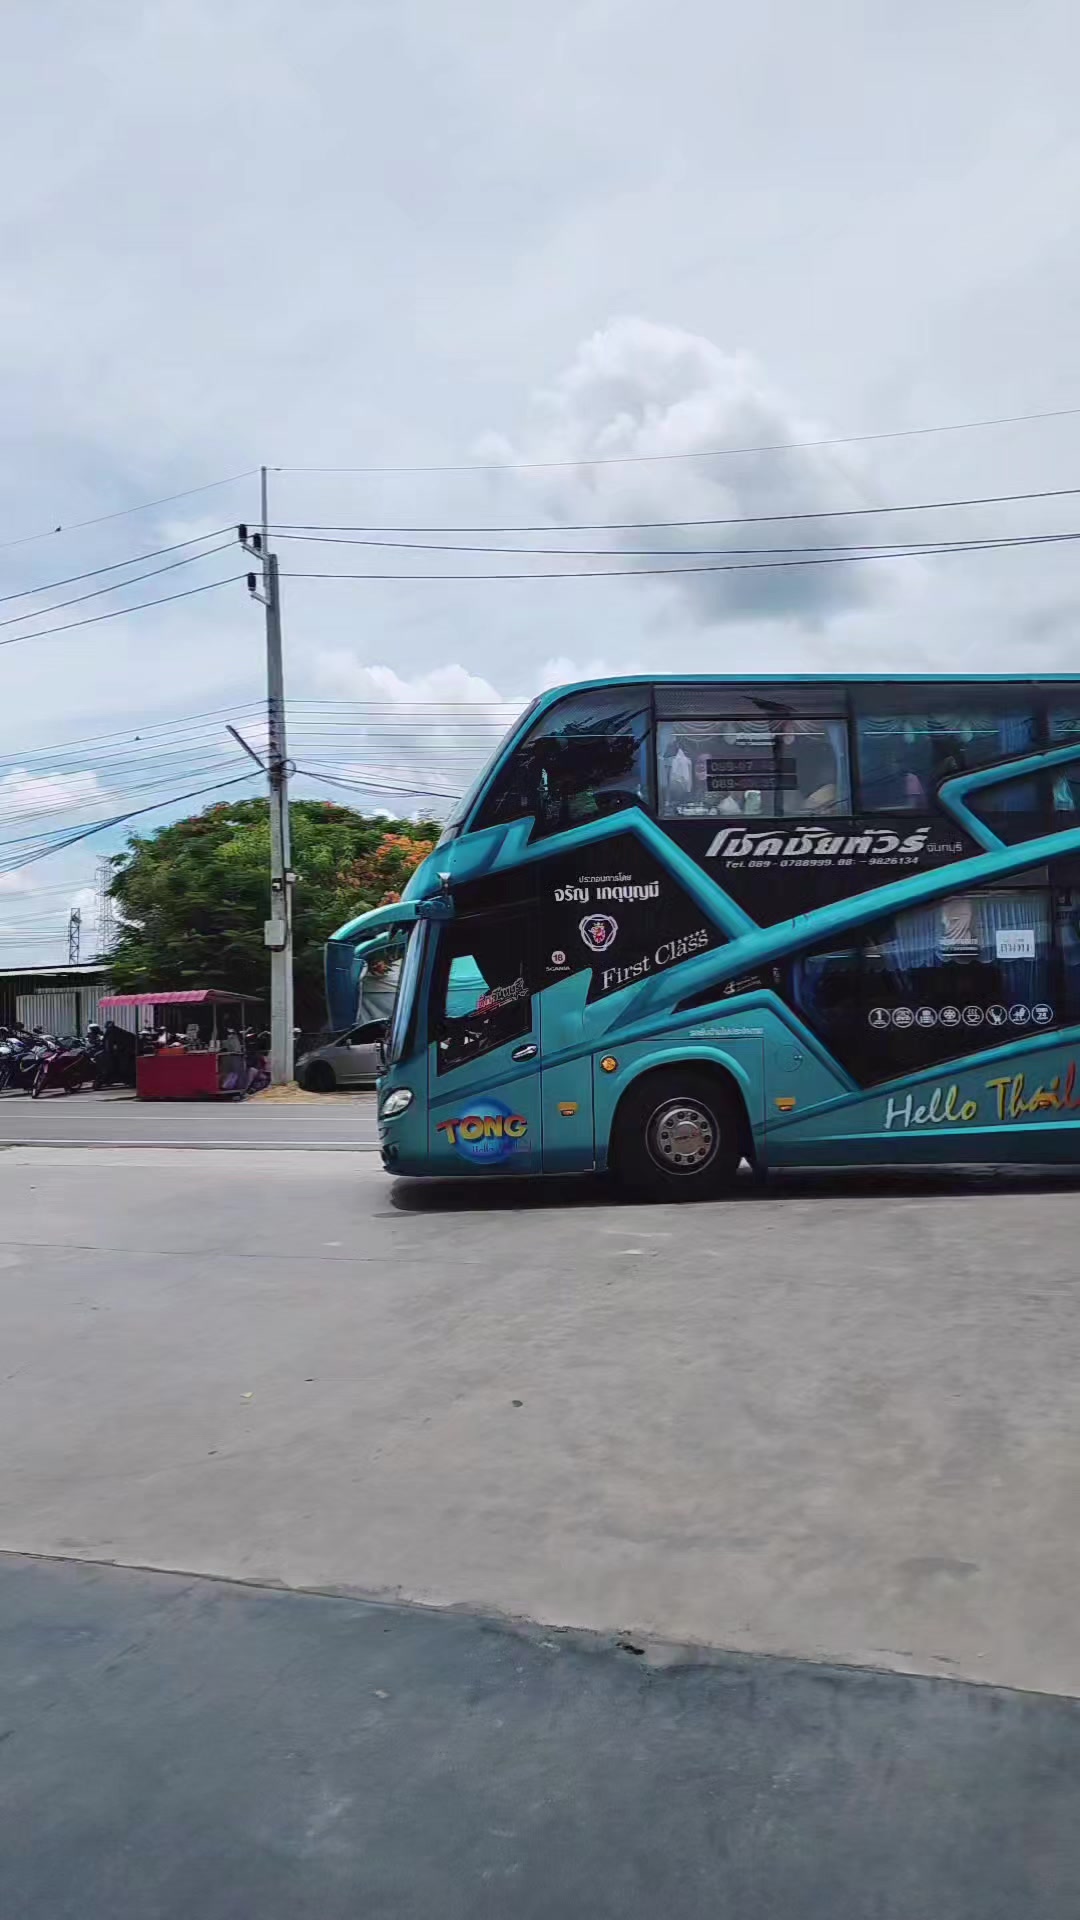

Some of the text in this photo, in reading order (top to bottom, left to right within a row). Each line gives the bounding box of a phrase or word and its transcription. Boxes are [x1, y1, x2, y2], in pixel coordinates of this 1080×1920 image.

[704, 826, 932, 857] โชคชัยทัวร์
[553, 880, 660, 904] จรัญ เกตุบุญมี
[601, 932, 709, 991] First Class
[884, 1084, 977, 1129] Hello
[436, 1114, 528, 1144] TONG
